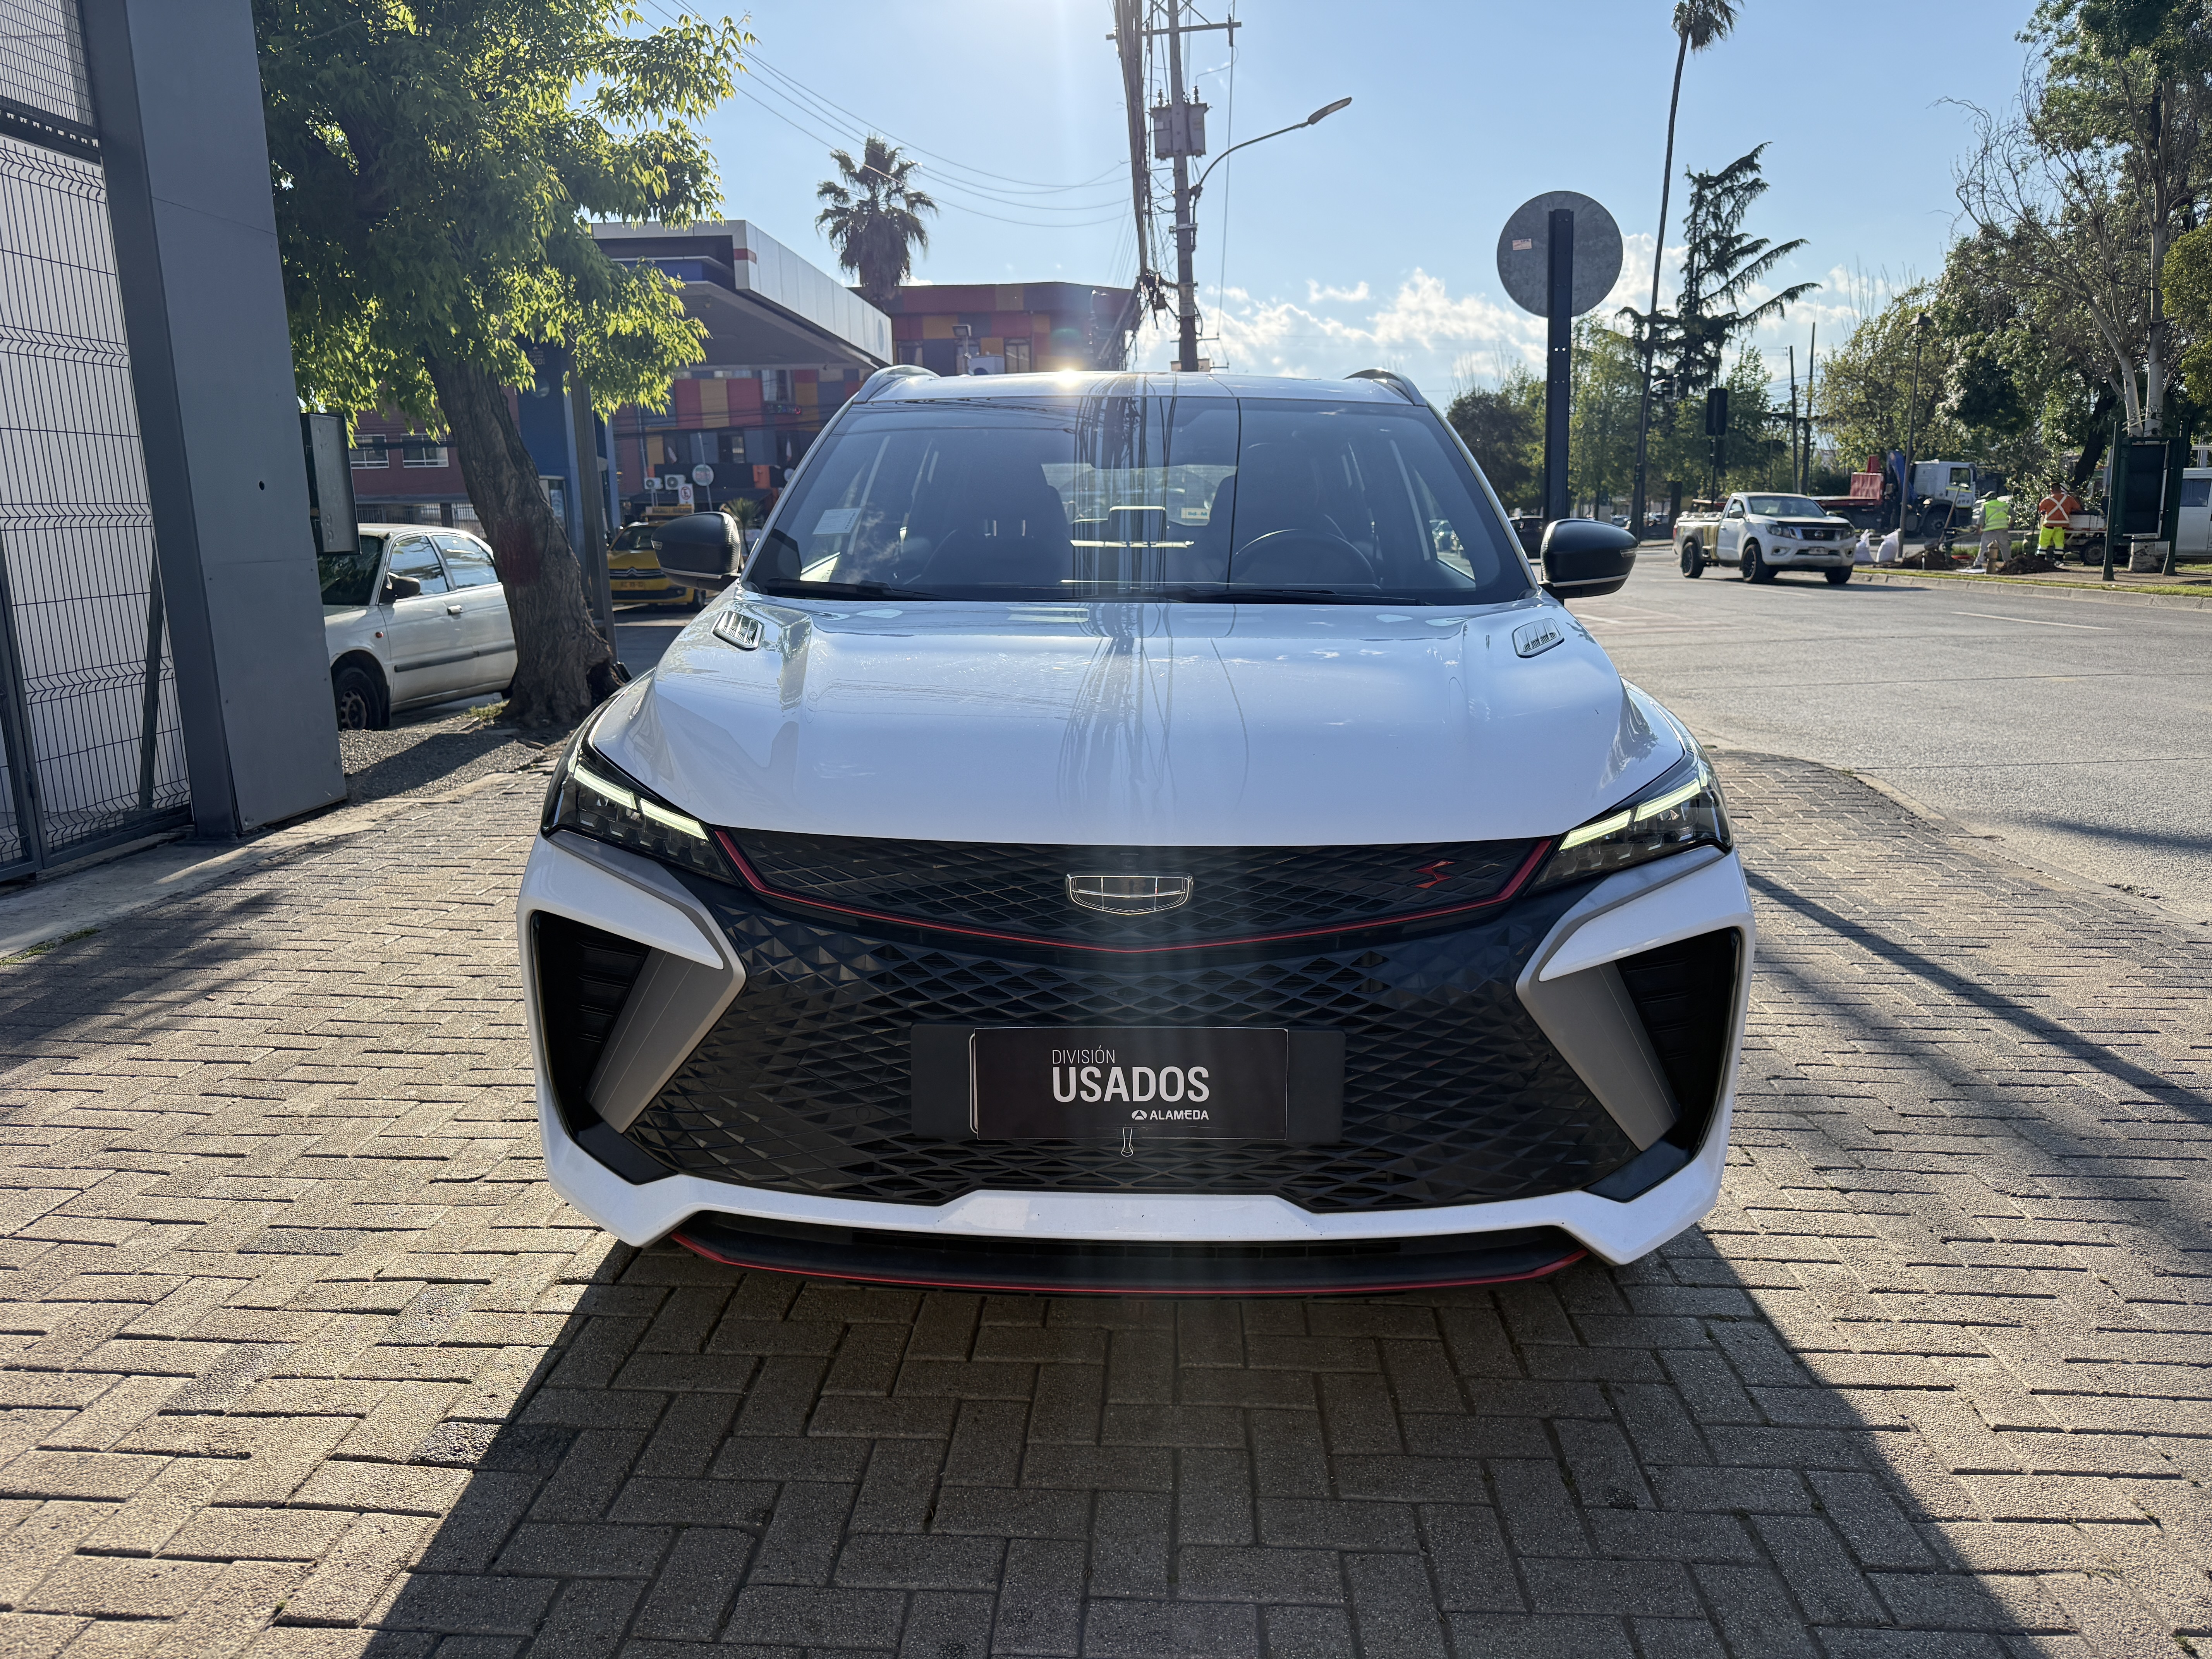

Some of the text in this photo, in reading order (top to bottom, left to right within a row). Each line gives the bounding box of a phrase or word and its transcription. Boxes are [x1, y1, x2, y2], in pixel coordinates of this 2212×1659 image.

[1052, 1045, 1115, 1064] DIVISIÓN
[1053, 1066, 1209, 1103] USADOS
[1149, 1110, 1209, 1120] ALAMEDA
